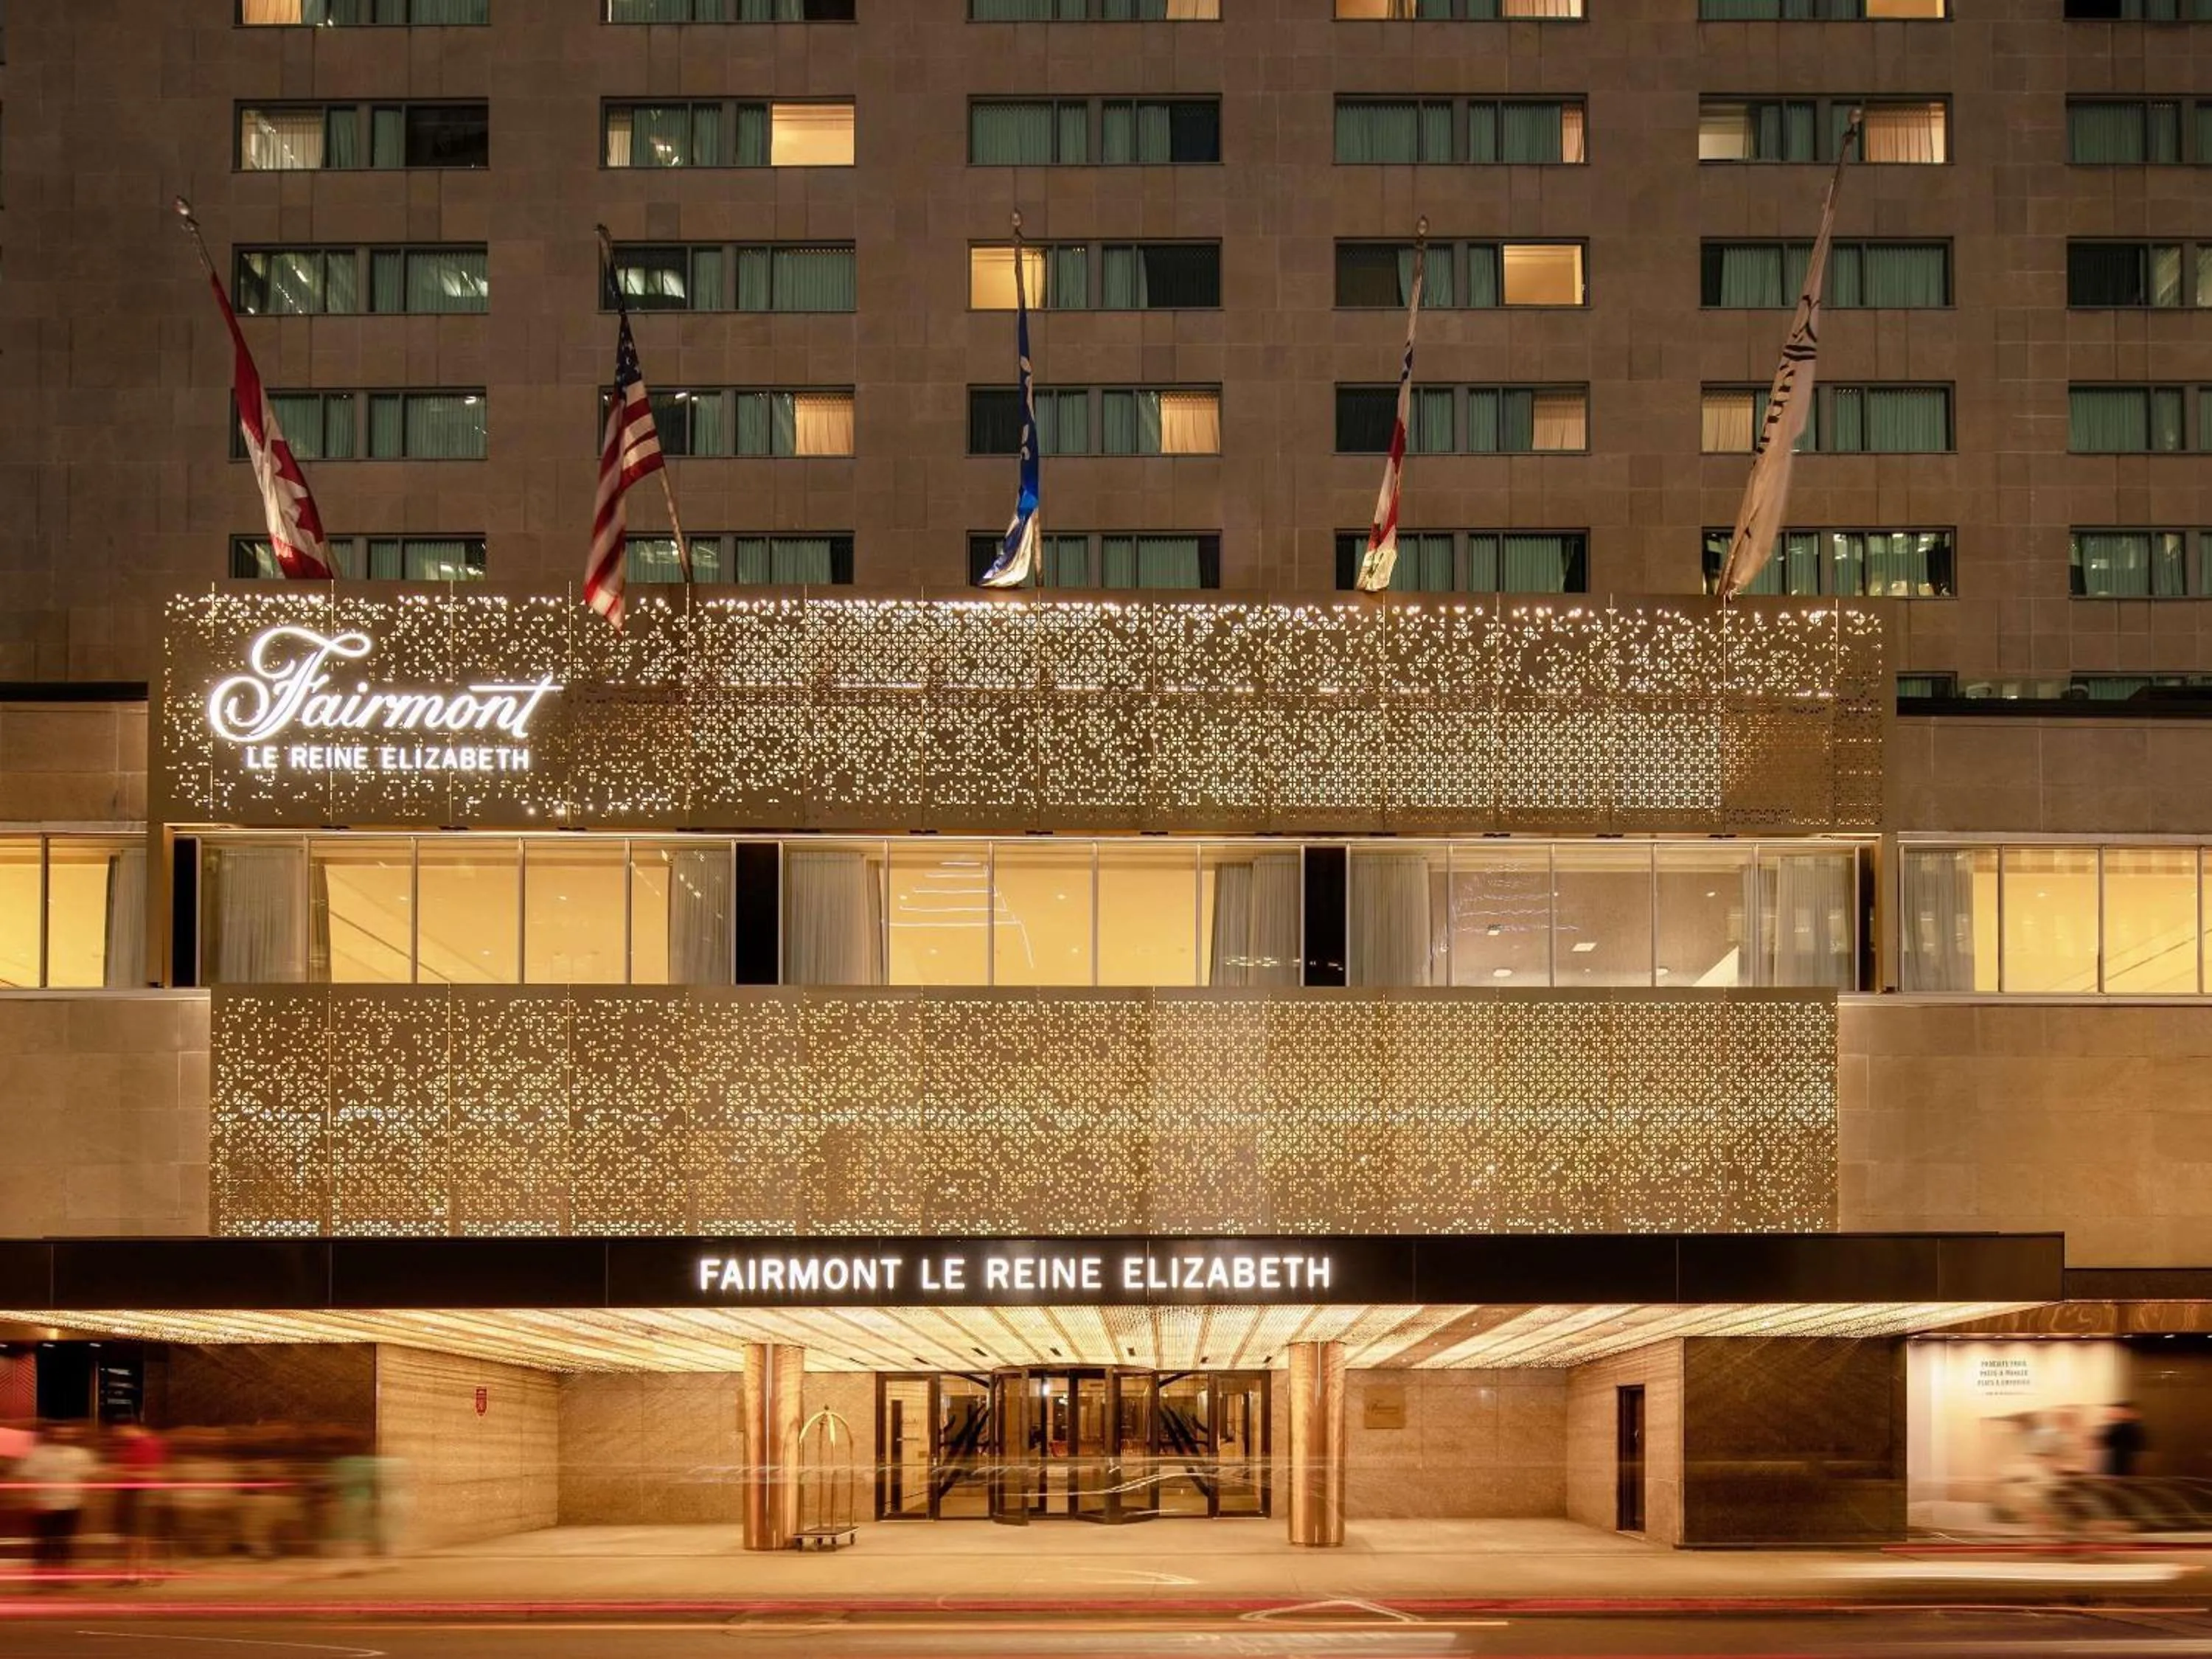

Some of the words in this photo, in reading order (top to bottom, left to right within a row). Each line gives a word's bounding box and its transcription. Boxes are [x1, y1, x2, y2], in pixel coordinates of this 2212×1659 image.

[209, 626, 564, 742] Fairmont
[246, 748, 277, 768] LE
[291, 748, 368, 768] REINE
[381, 748, 529, 769] ELIZABETH
[700, 1259, 902, 1289] FAIRMONT
[922, 1259, 965, 1289] LE
[987, 1258, 1102, 1288] REINE
[1124, 1257, 1329, 1287] ELIZABETH
